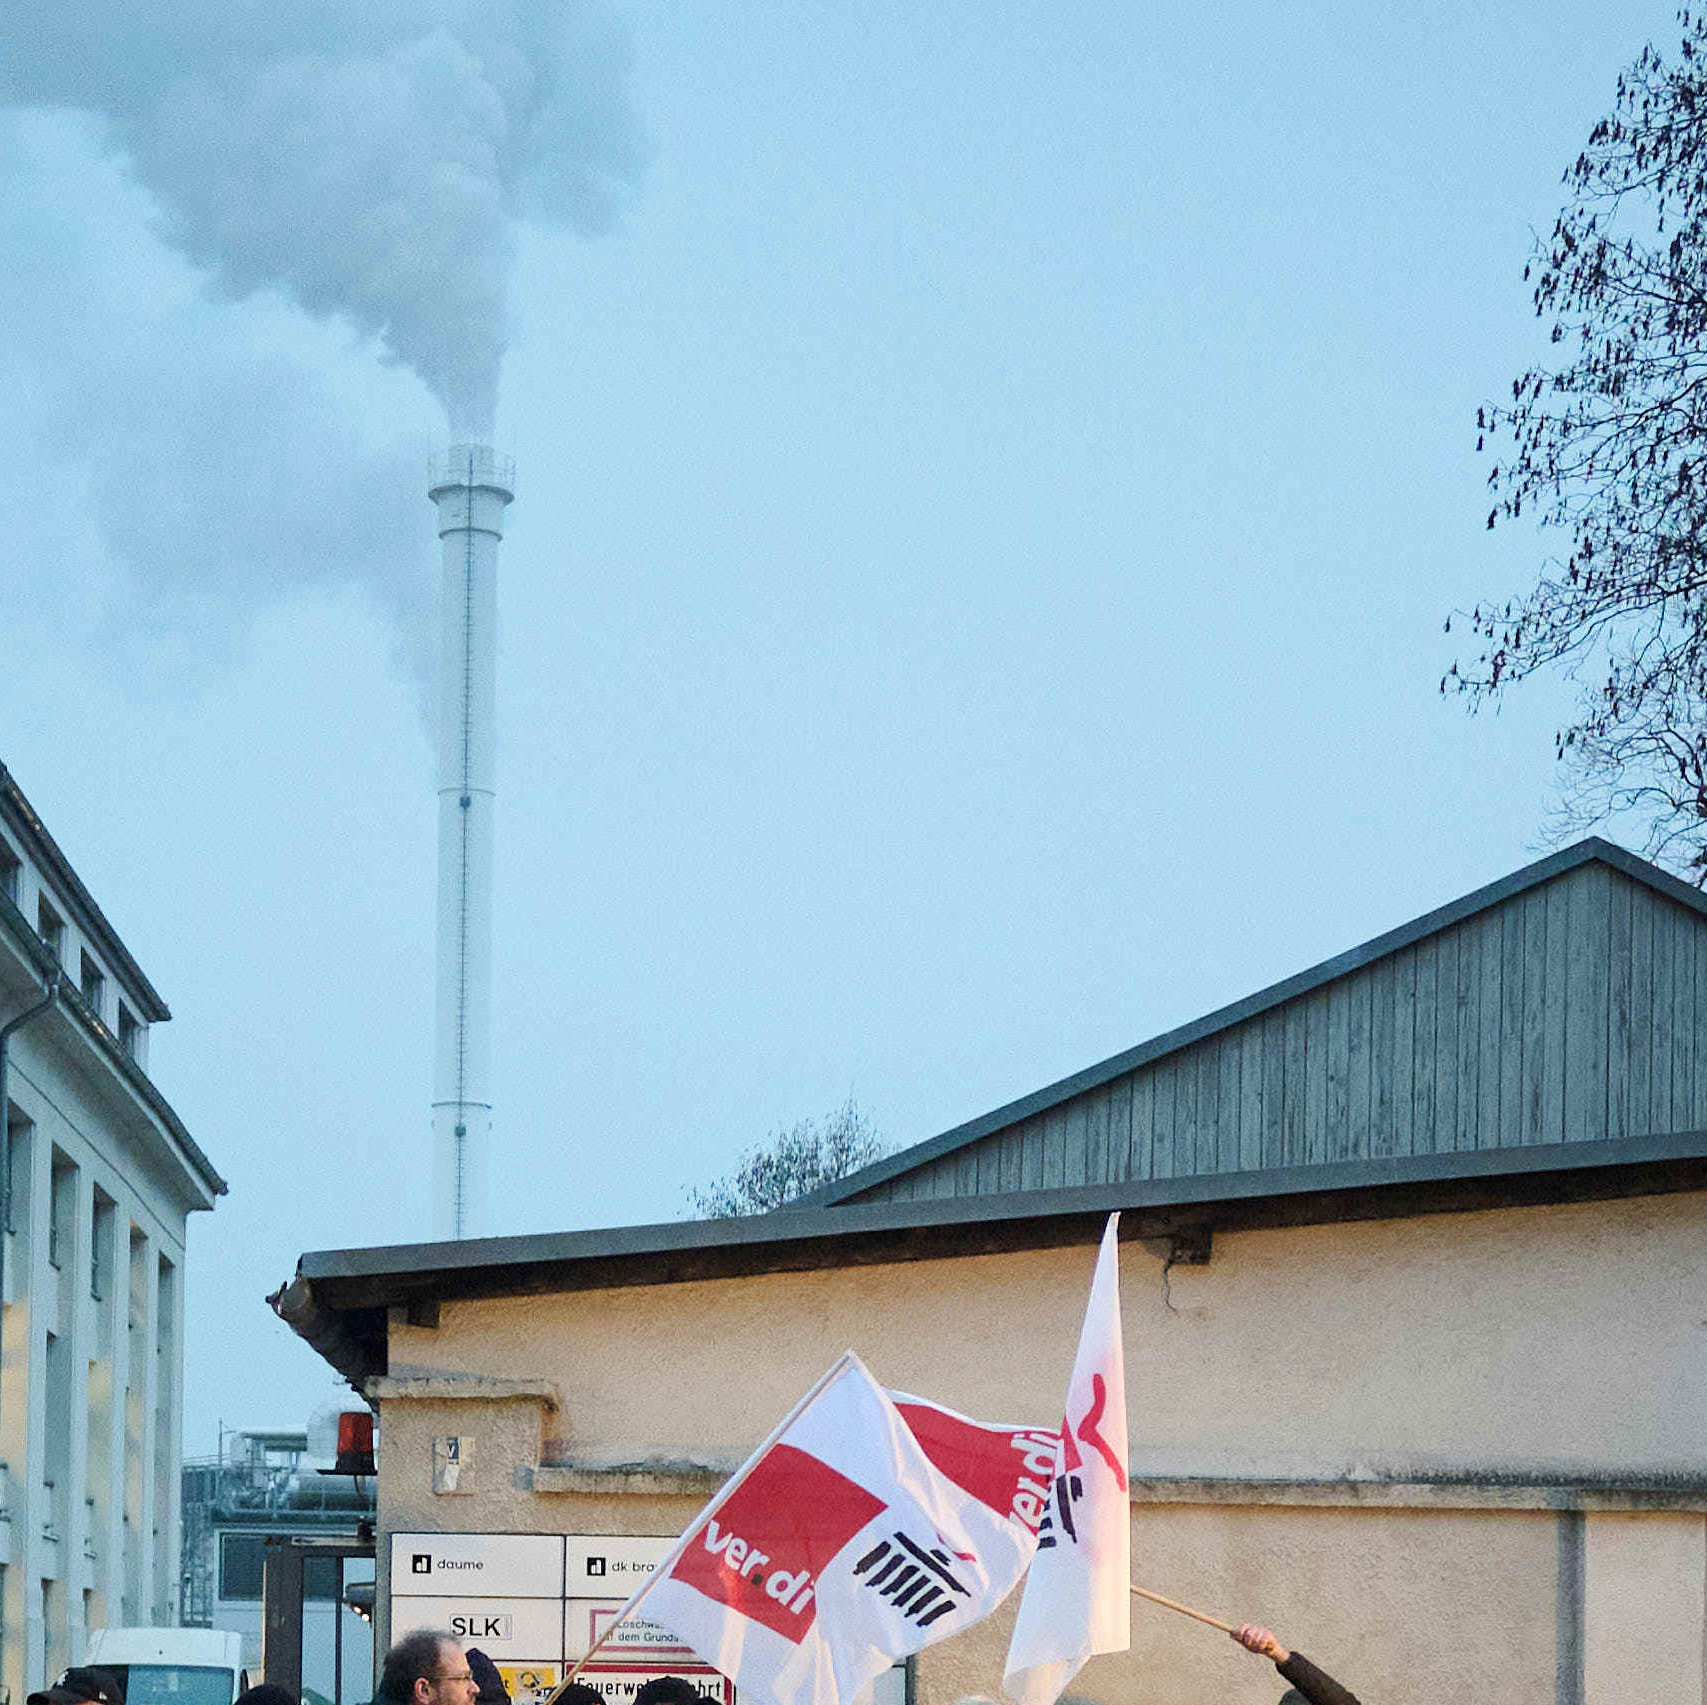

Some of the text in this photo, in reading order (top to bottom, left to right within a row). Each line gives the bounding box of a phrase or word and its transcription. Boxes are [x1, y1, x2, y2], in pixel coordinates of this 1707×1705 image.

[437, 1559, 484, 1570] daume
[612, 1561, 627, 1572] dk
[705, 1519, 815, 1615] ver.di
[452, 1617, 501, 1636] SLK
